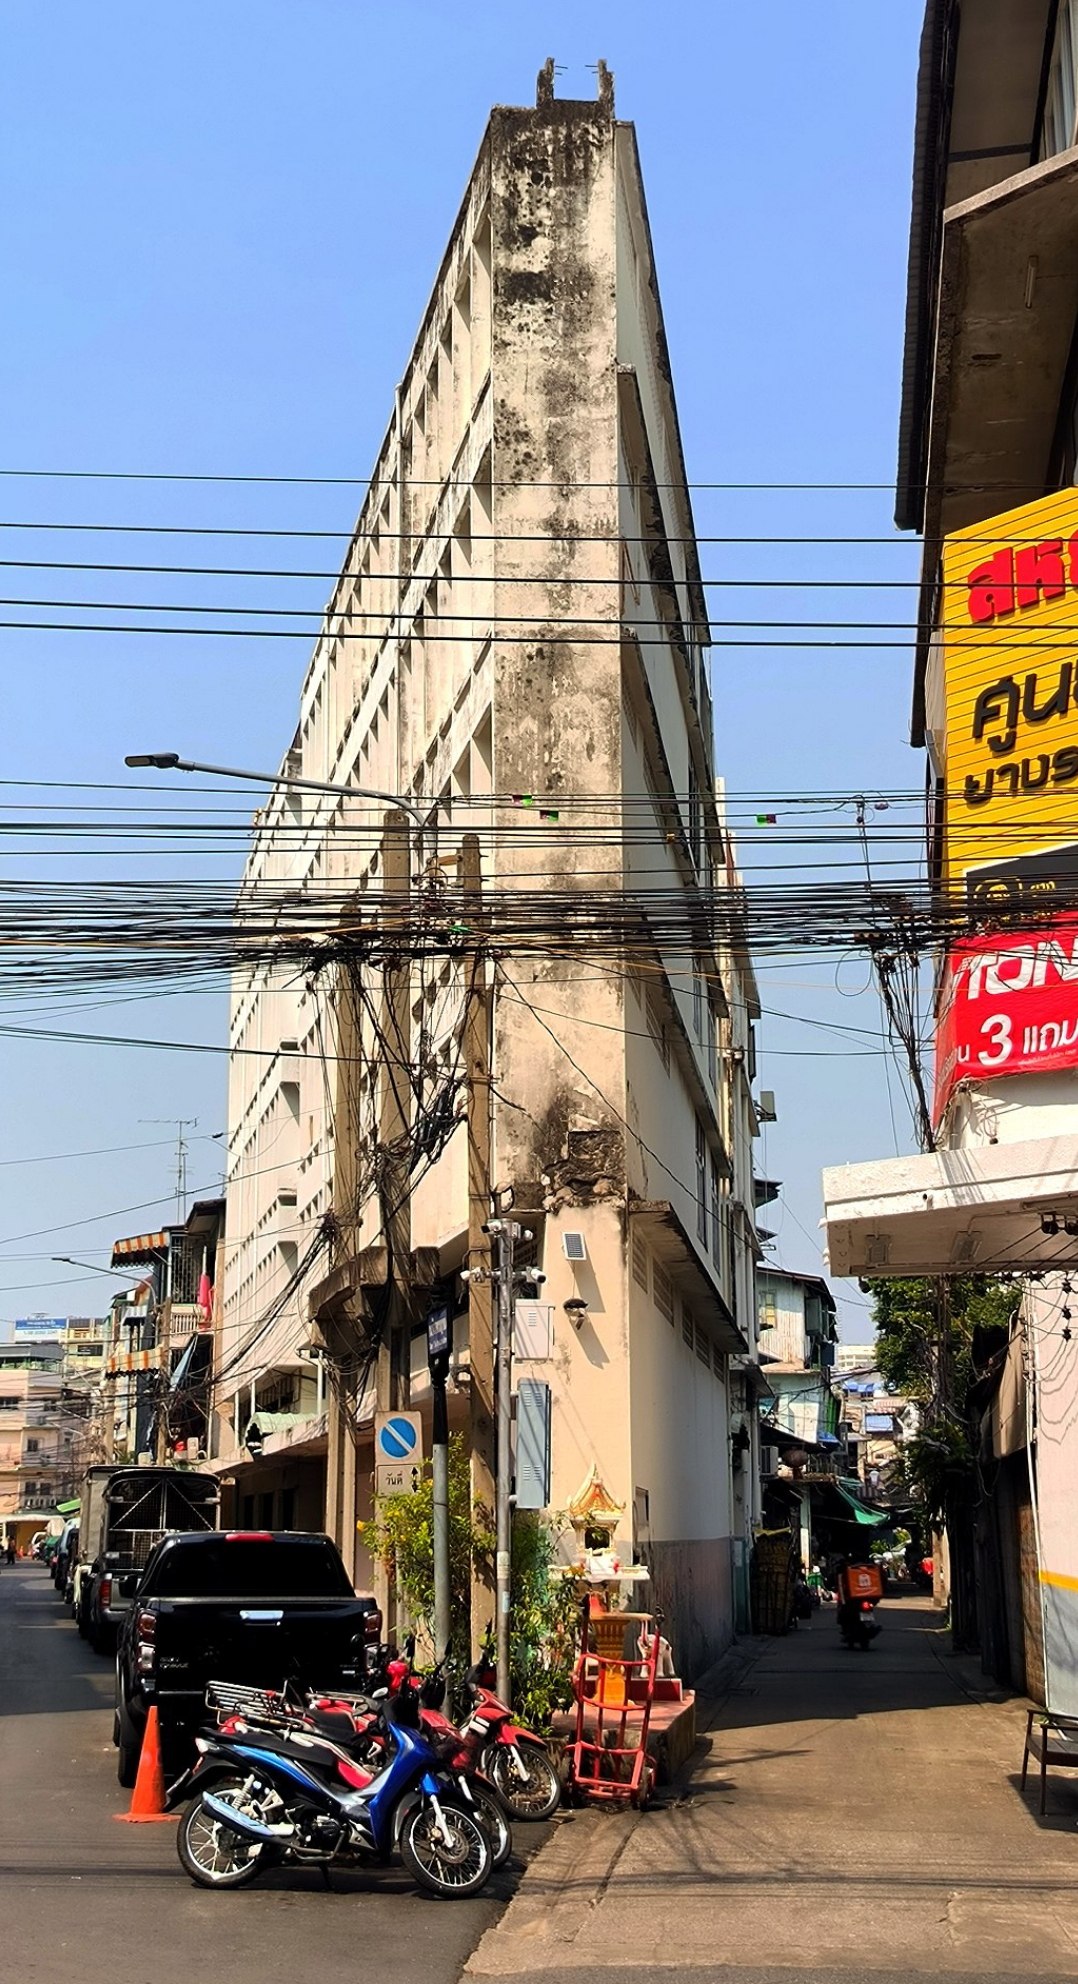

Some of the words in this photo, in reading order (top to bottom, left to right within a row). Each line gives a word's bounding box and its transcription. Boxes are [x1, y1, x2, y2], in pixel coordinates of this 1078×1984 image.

[967, 528, 1078, 624] สห
[972, 661, 1078, 753] ศูน
[977, 1013, 1012, 1066] 3
